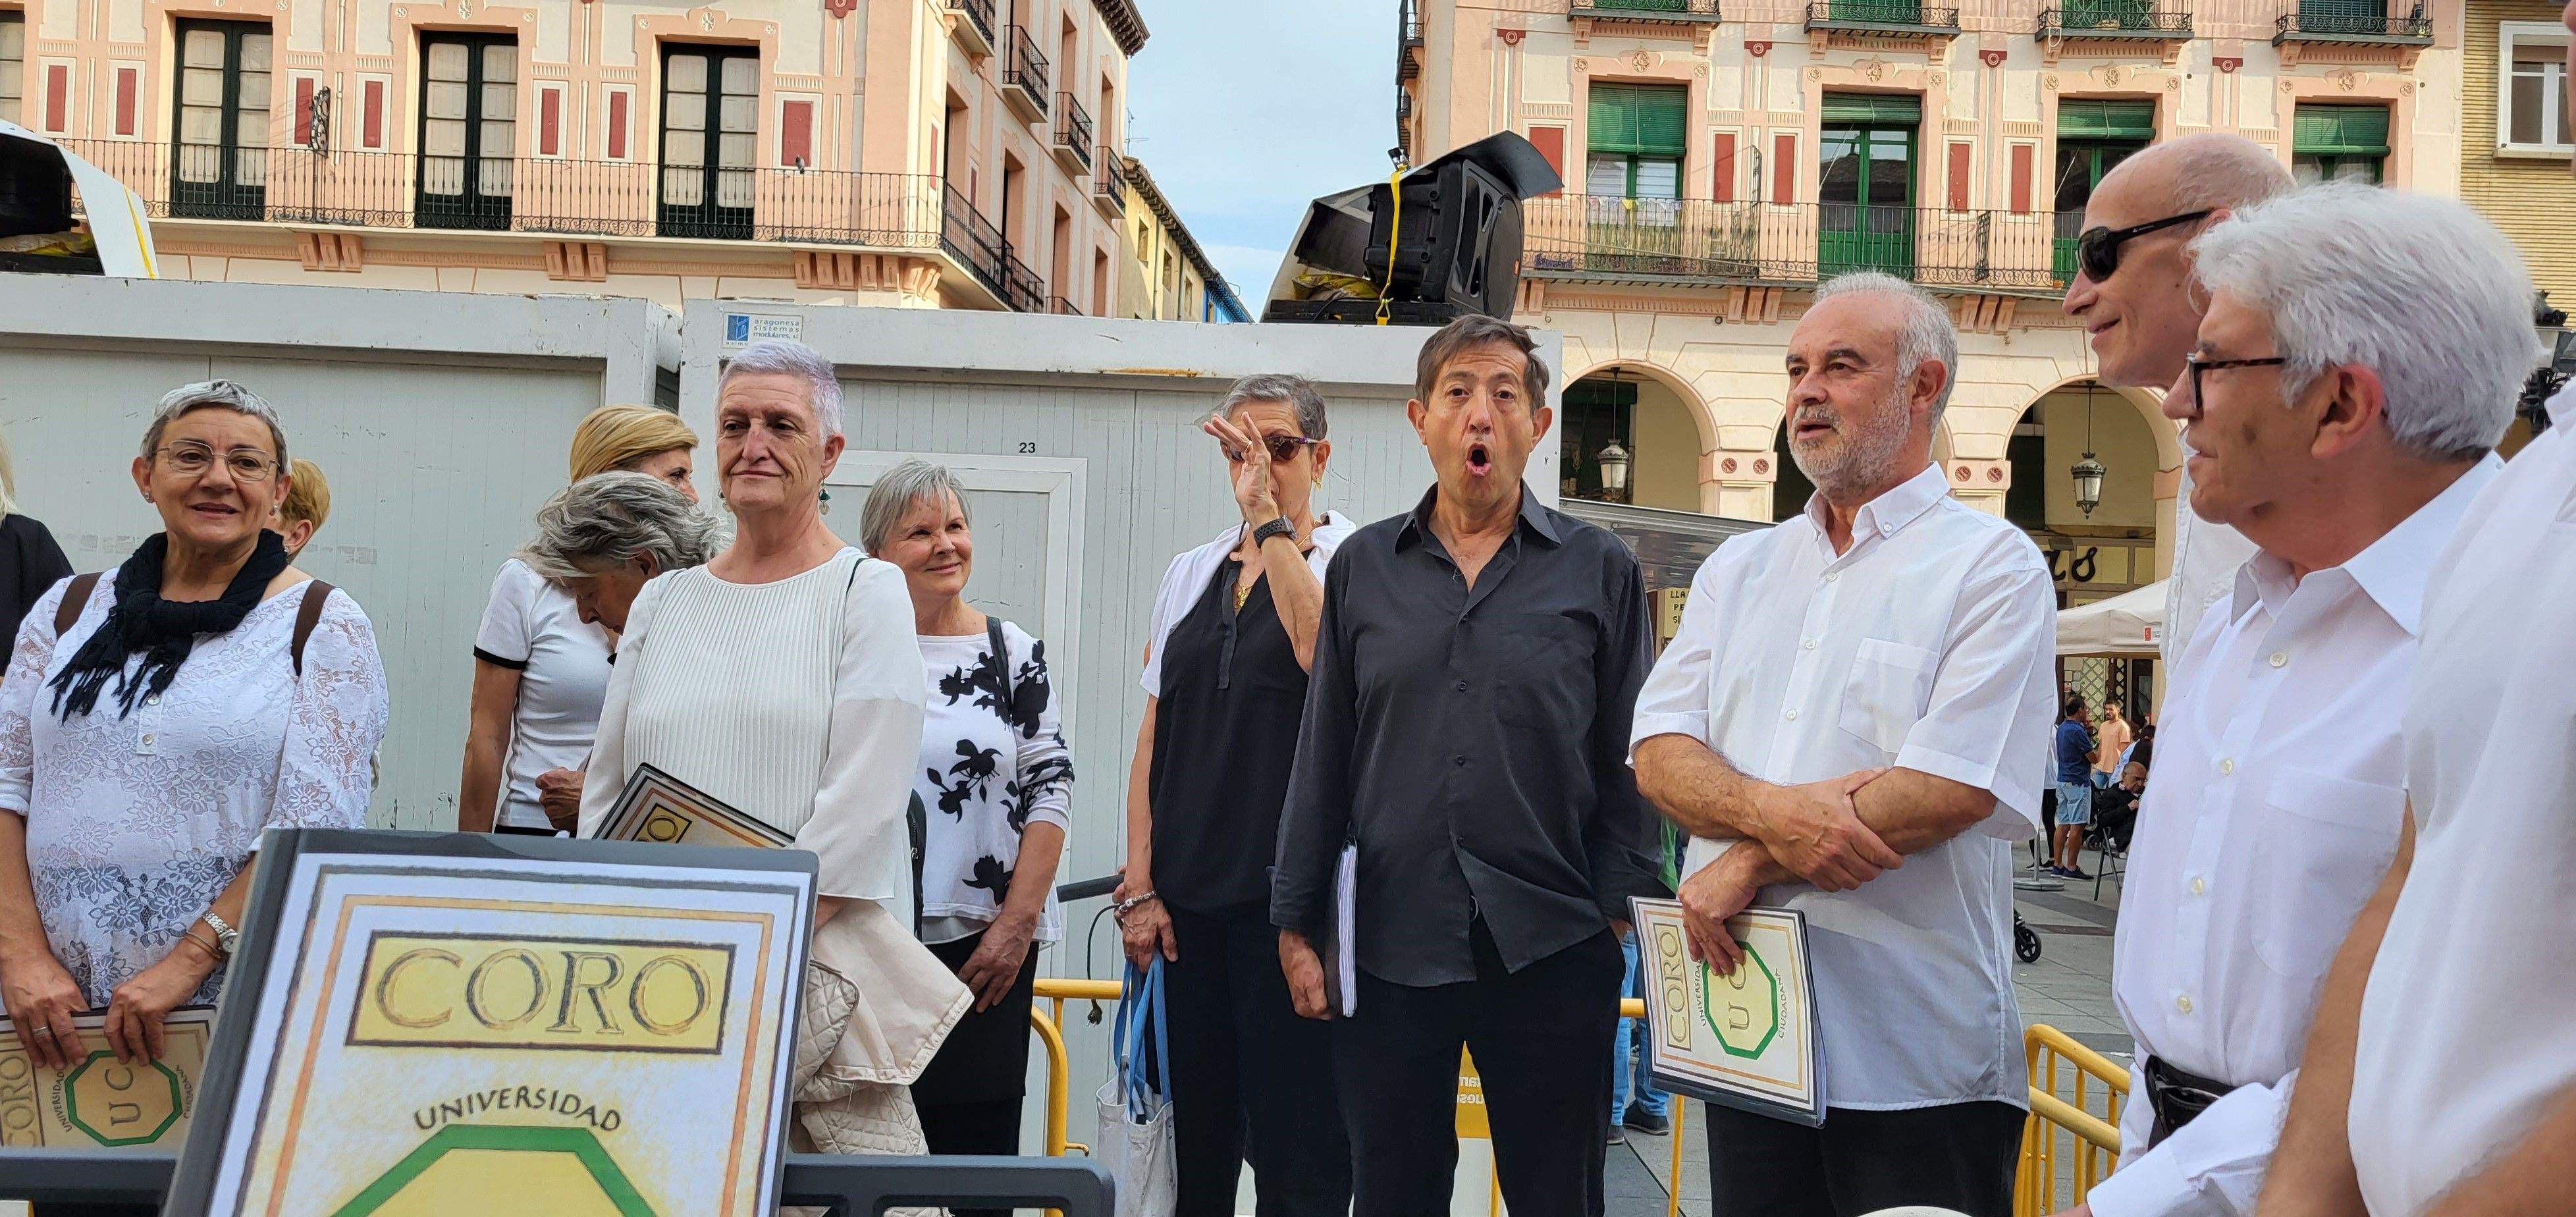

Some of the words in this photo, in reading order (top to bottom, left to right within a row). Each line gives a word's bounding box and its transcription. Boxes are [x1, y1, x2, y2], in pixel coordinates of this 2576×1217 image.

[1019, 442, 1036, 453] 23
[1670, 590, 1689, 599] LLA
[376, 948, 712, 1035] CORO
[1659, 931, 1687, 1043] CORO
[1775, 967, 1788, 1039] CIUDADANA
[413, 1085, 622, 1131] UNIVERSIDAD
